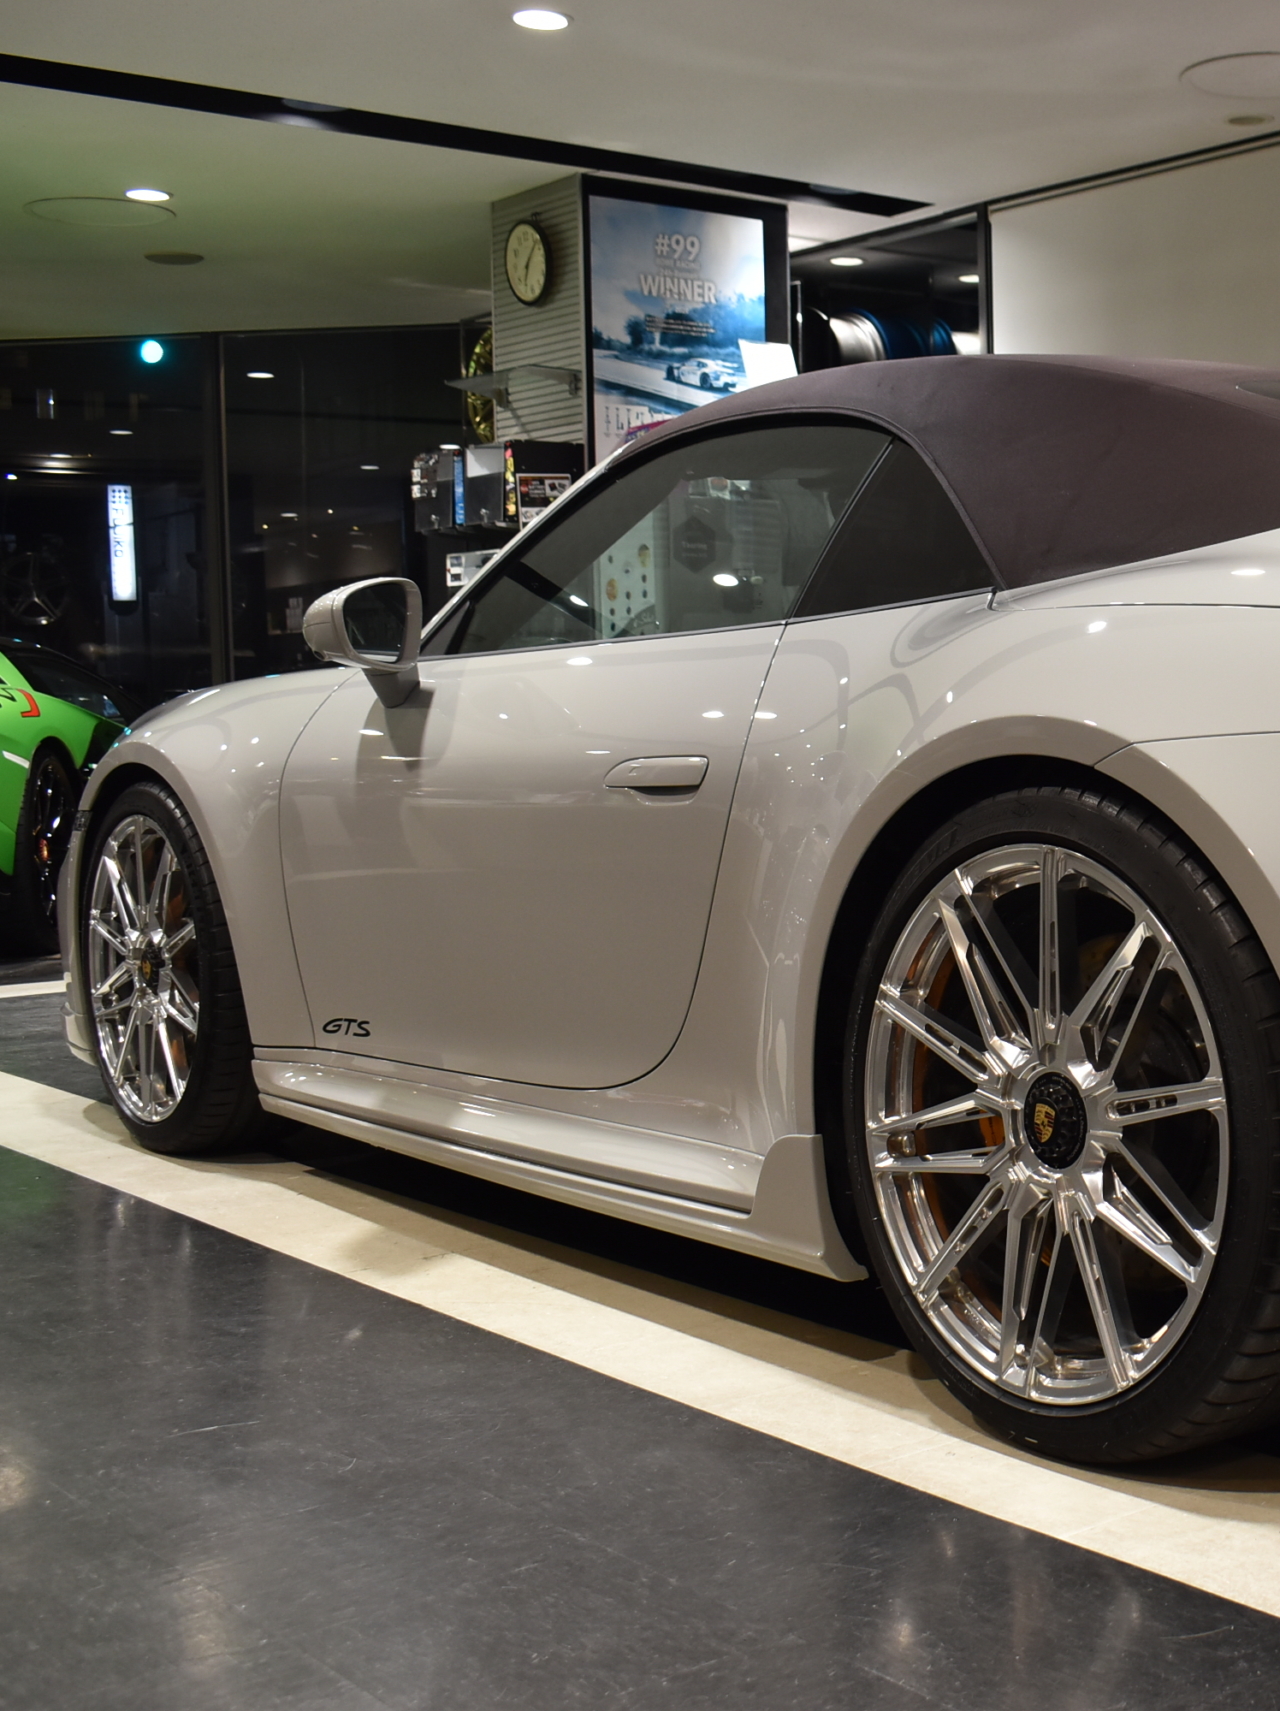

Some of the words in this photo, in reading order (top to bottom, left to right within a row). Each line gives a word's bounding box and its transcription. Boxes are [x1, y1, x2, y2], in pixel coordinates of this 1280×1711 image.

[654, 233, 701, 261] #99
[640, 274, 717, 304] WINNER
[322, 1017, 371, 1037] GTS
